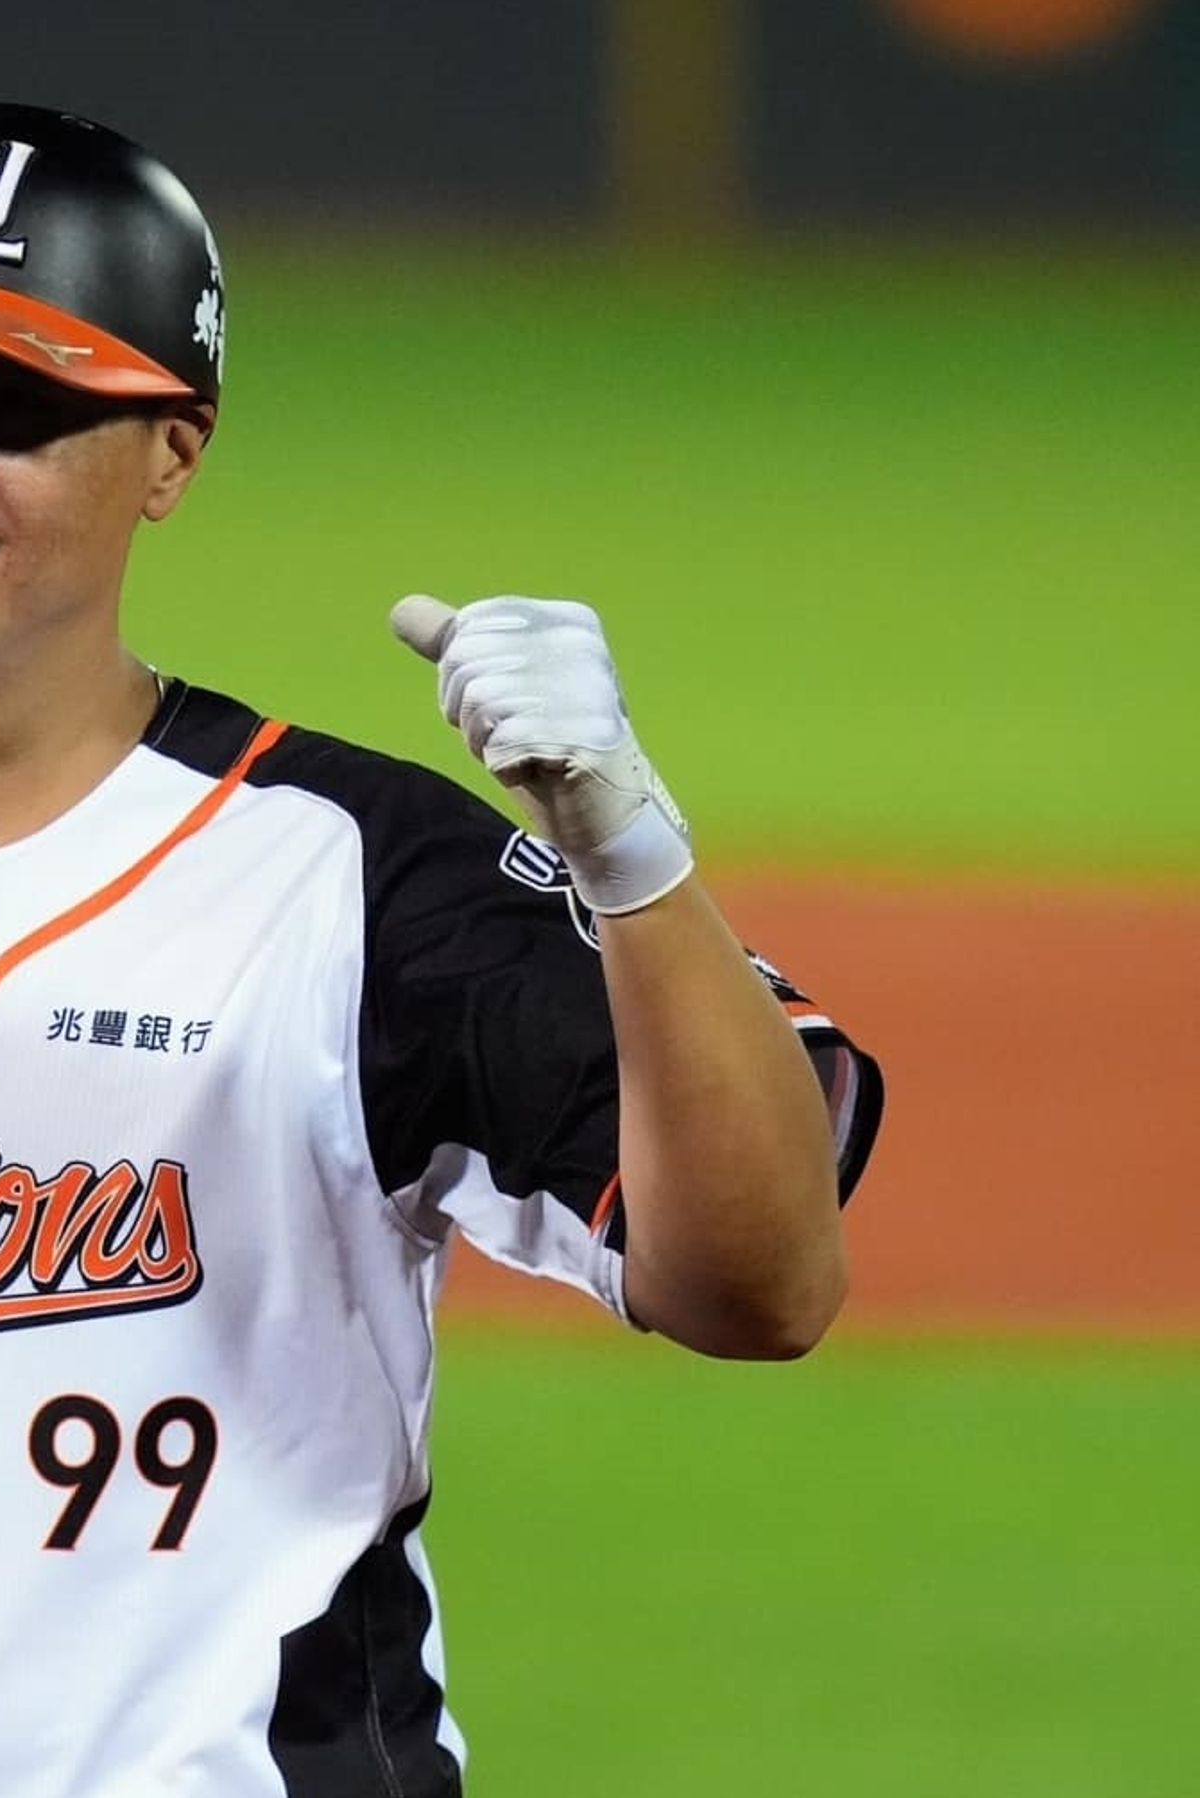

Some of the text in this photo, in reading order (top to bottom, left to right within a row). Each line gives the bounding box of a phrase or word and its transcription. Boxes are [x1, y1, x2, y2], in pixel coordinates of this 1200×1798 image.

[46, 1006, 214, 1054] 兆豐銀行
[28, 1393, 218, 1550] 99
